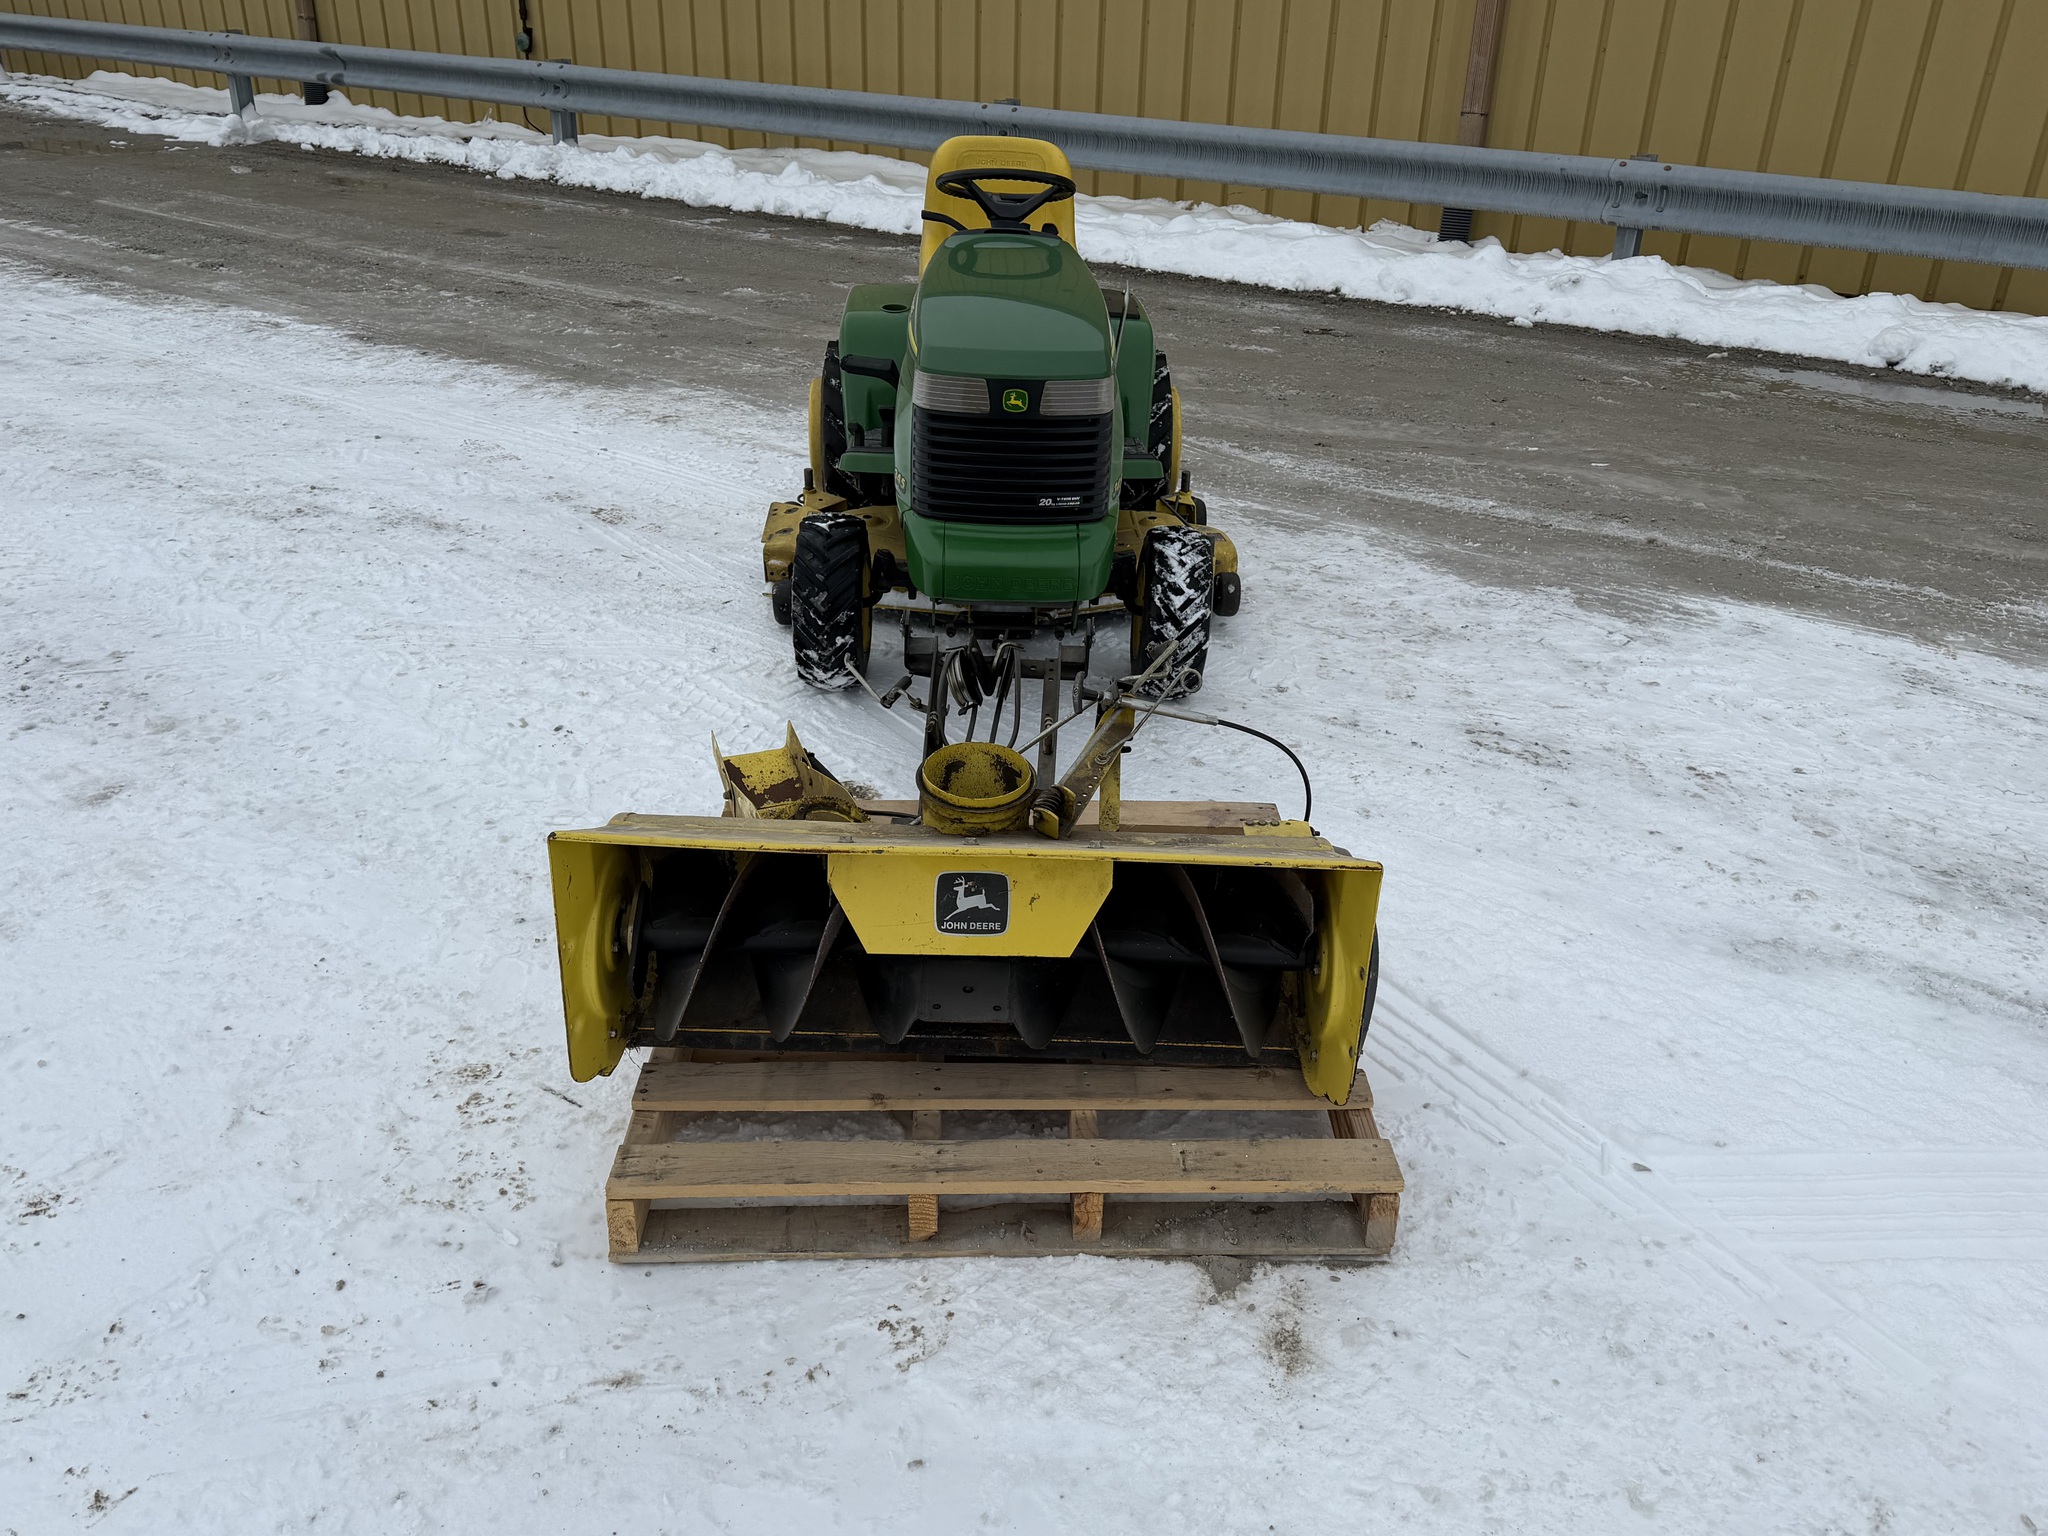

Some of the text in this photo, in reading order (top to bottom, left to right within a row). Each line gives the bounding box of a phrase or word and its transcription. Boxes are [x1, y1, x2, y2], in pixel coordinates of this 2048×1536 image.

[1038, 498, 1053, 507] 20
[950, 575, 1075, 593] JOHN DEERE
[941, 921, 1001, 931] JOHN DEERE
